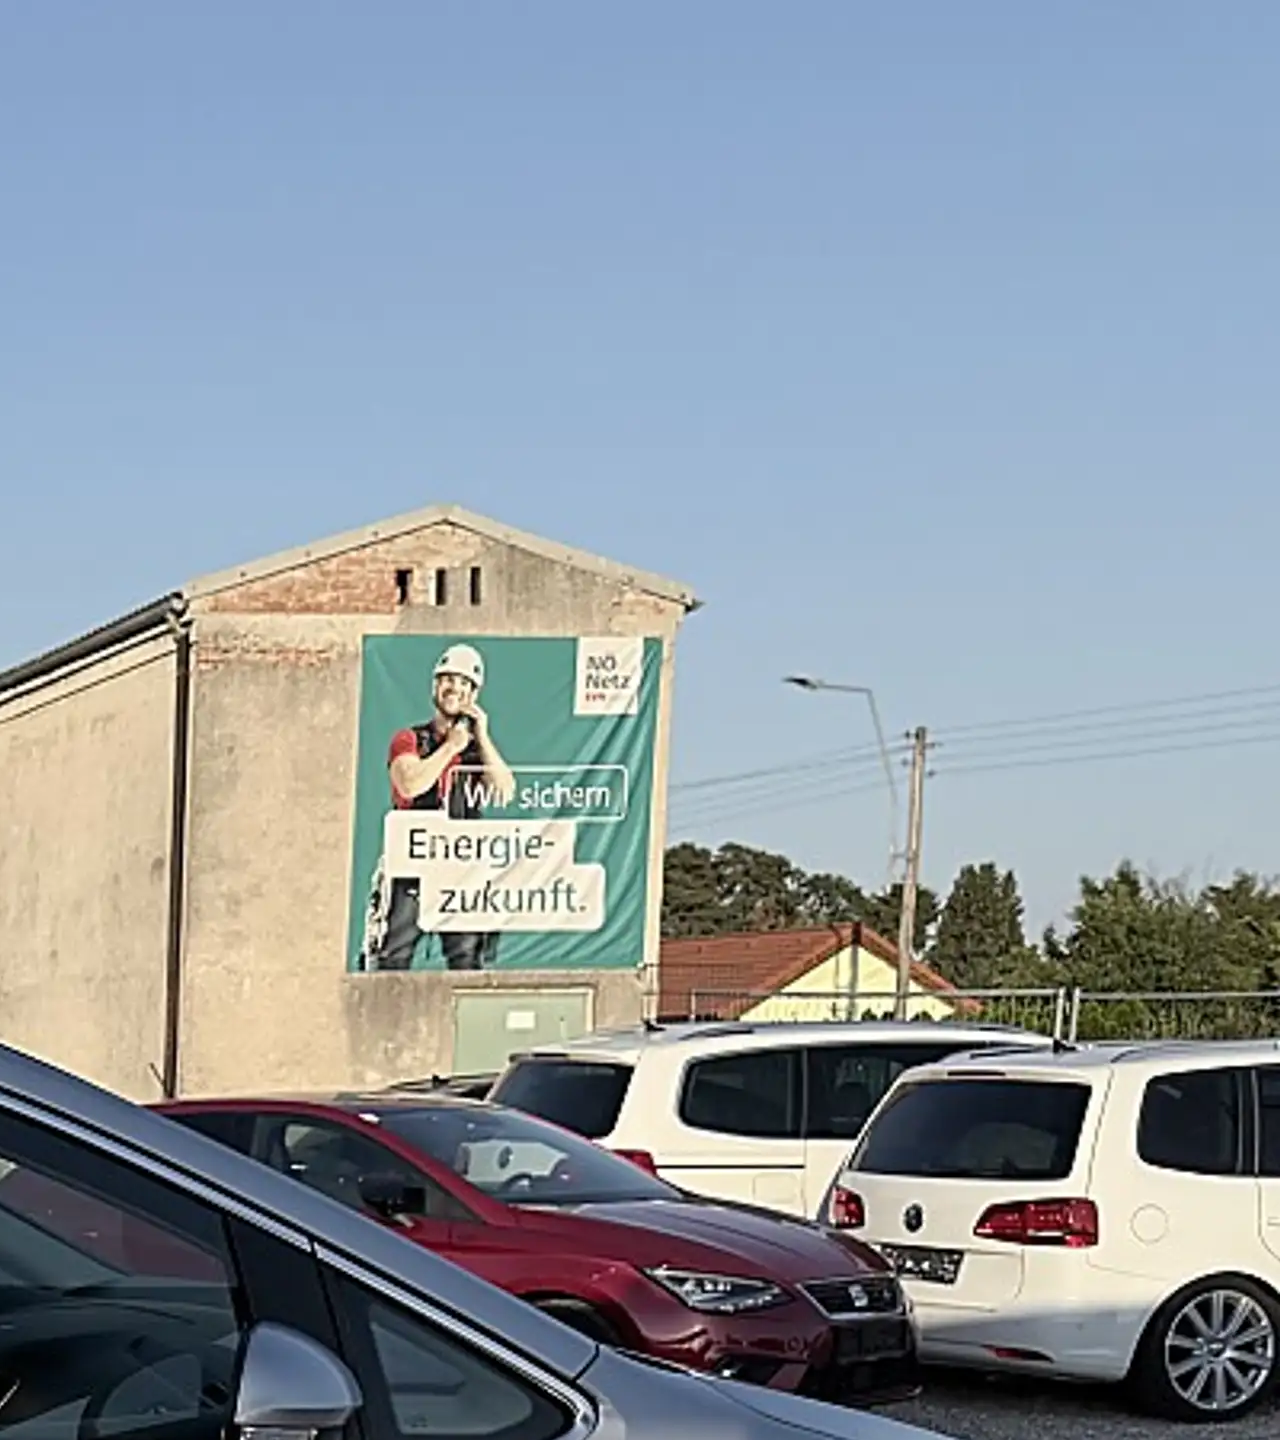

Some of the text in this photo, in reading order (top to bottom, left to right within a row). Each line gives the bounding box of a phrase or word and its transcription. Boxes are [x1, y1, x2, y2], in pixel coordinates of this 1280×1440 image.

[586, 673, 632, 690] Netz
[519, 780, 611, 809] sichern
[408, 828, 555, 868] Energie-
[439, 879, 587, 914] zukunft.
